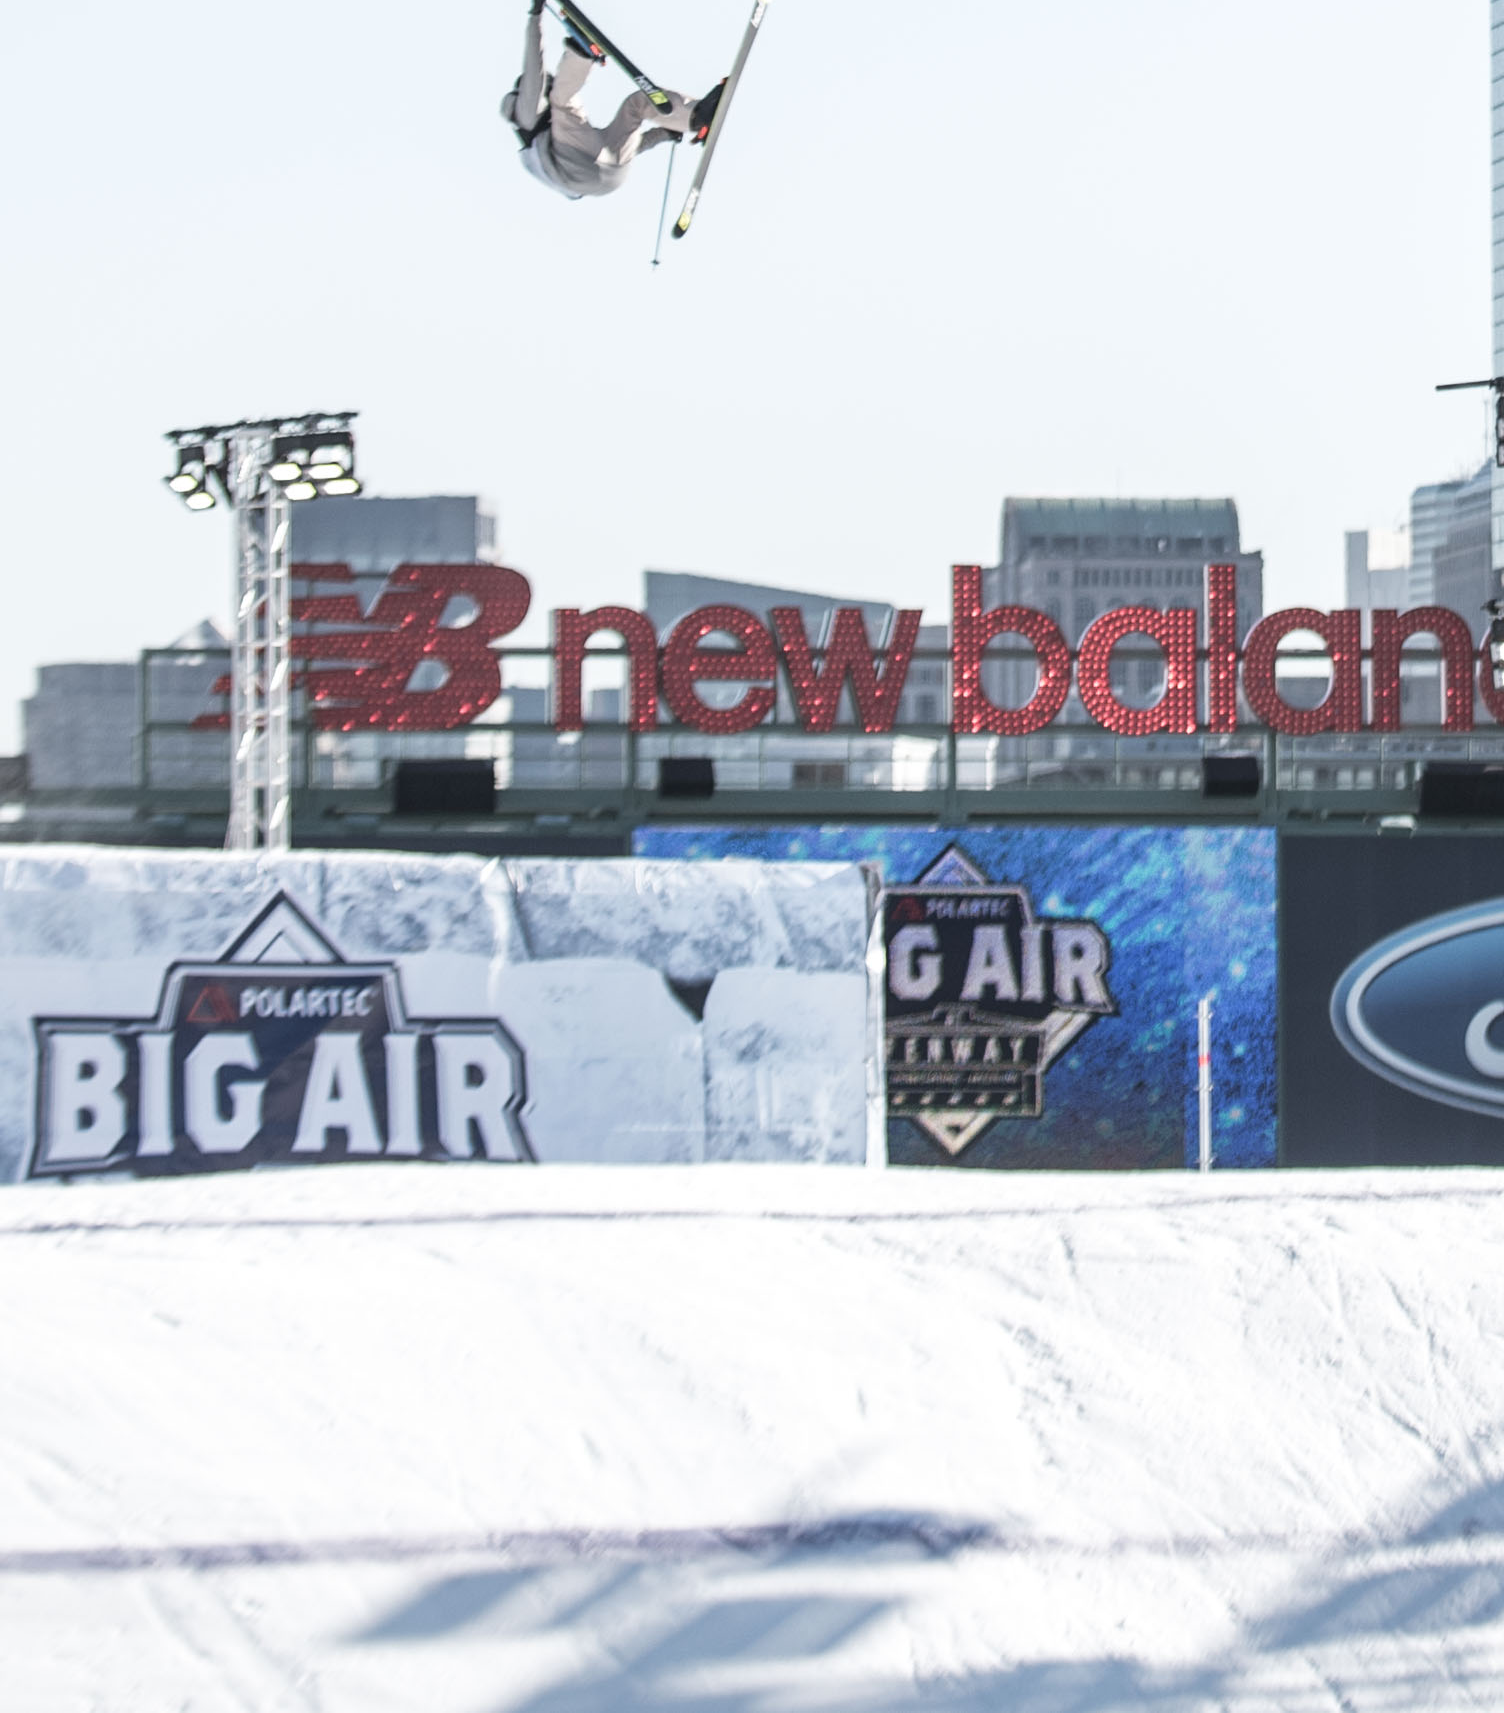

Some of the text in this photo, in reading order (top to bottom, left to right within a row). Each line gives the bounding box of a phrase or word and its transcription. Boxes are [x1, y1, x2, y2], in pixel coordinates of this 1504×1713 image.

[552, 604, 922, 735] new
[240, 985, 376, 1019] POLARTEC
[959, 923, 1108, 1006] AIR
[47, 1031, 521, 1163] BIG AIR
